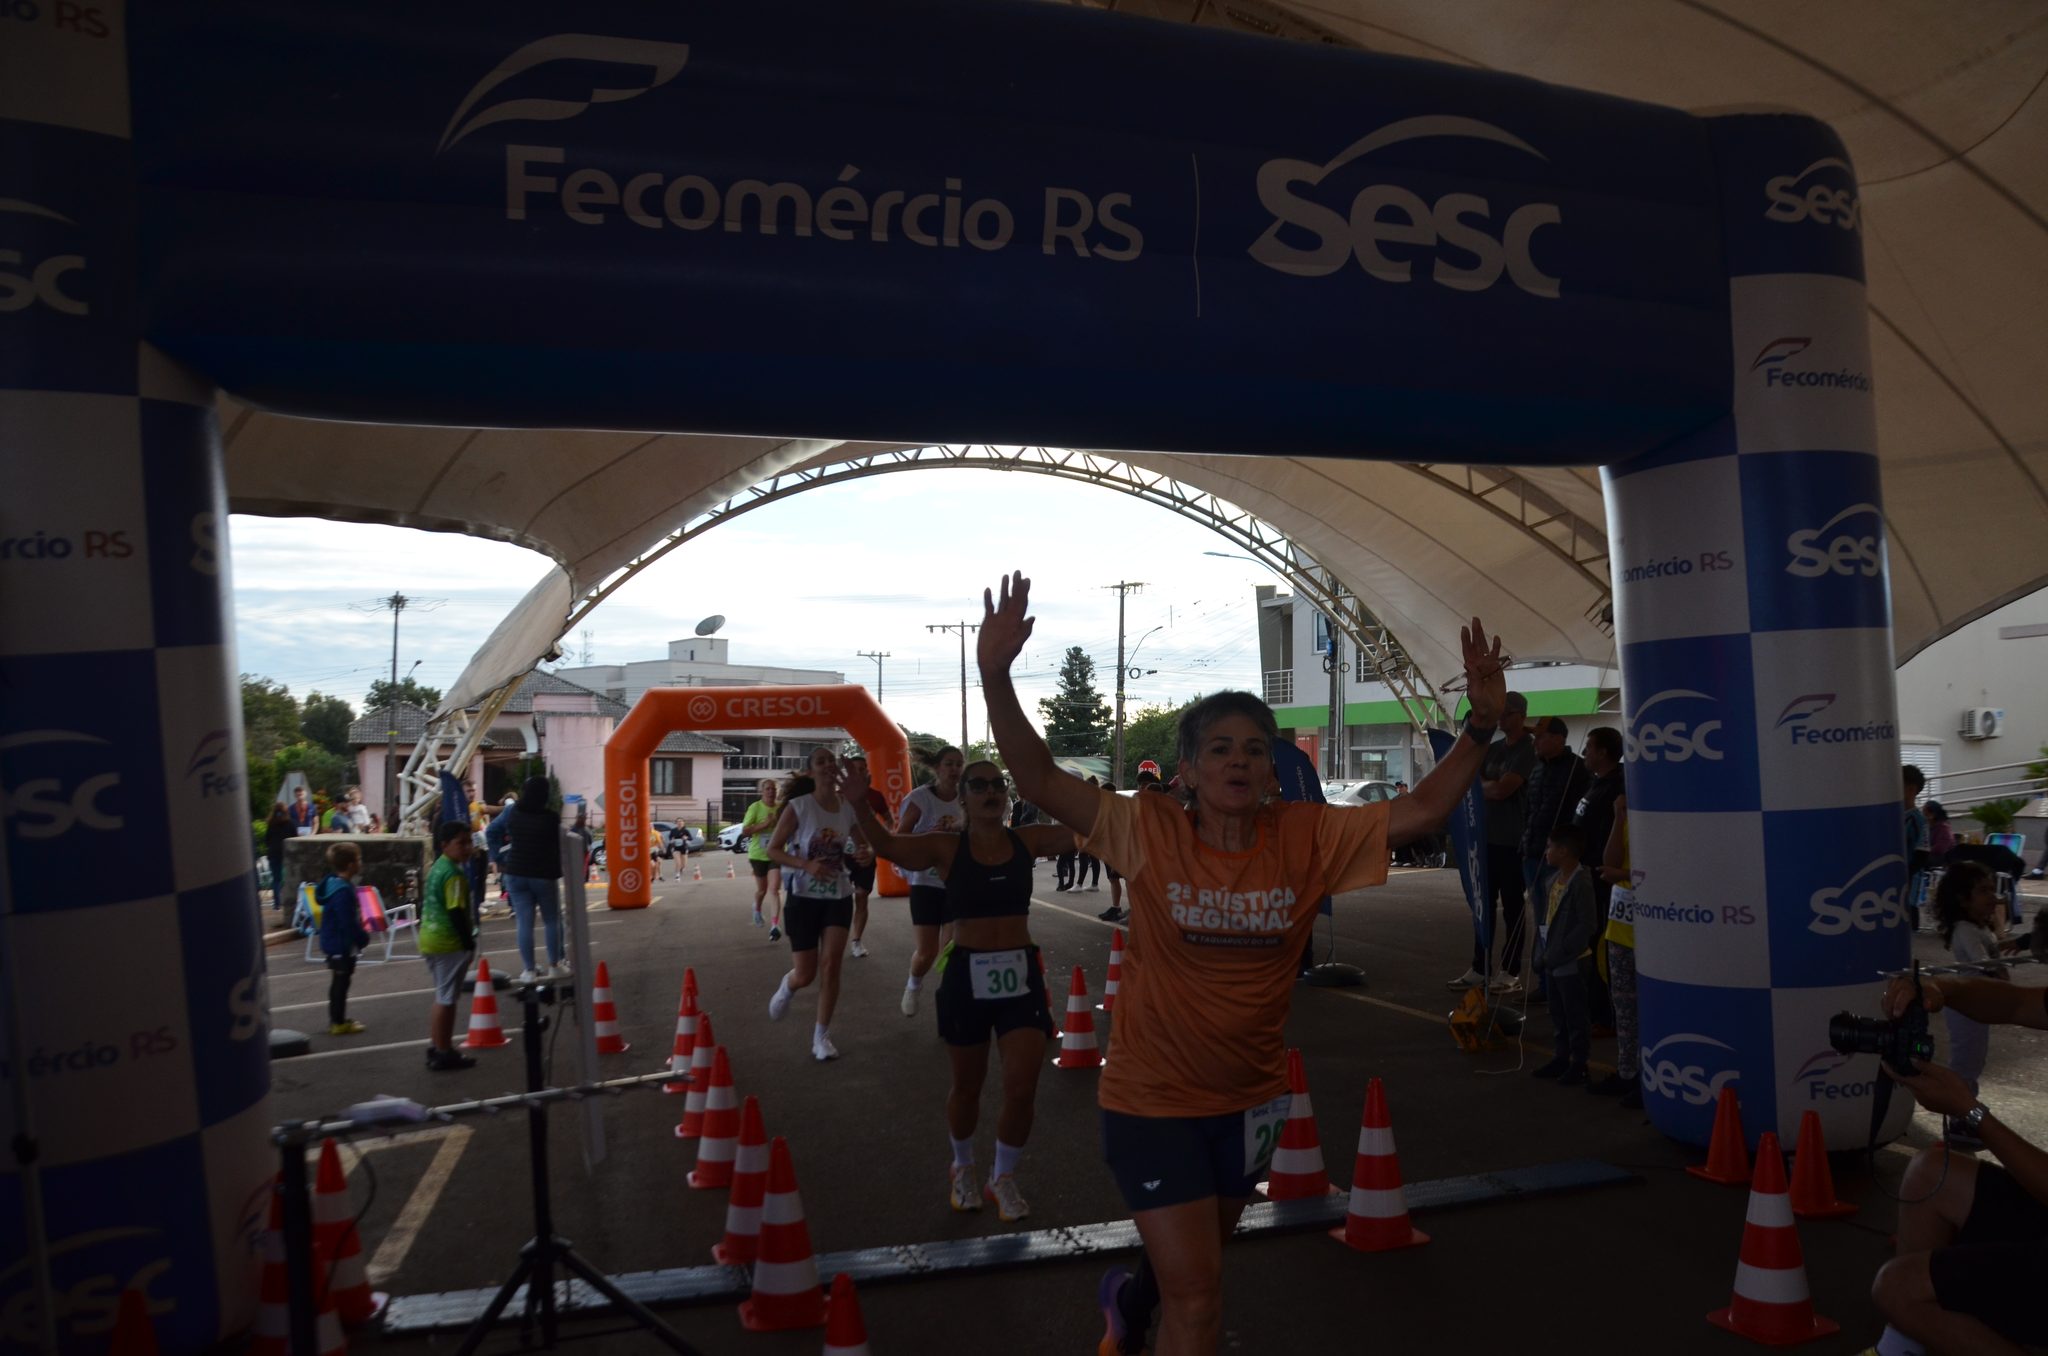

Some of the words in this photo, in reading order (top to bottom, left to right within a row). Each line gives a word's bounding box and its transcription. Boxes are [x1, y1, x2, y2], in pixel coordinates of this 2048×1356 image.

[505, 144, 1015, 252] Fecomércio
[1042, 186, 1145, 263] RS
[1247, 157, 1562, 298] Sesc
[0, 248, 90, 315] sc
[0, 530, 72, 559] rcio
[84, 530, 134, 559] RS
[1700, 550, 1734, 572] RS
[725, 695, 831, 718] CRESOL
[0, 771, 124, 839] sc
[619, 772, 640, 862] CRESOL
[1198, 885, 1297, 912] RÚSTICA
[1171, 903, 1295, 932] REGIONAL
[1722, 904, 1756, 925] RS
[986, 967, 1018, 994] 30
